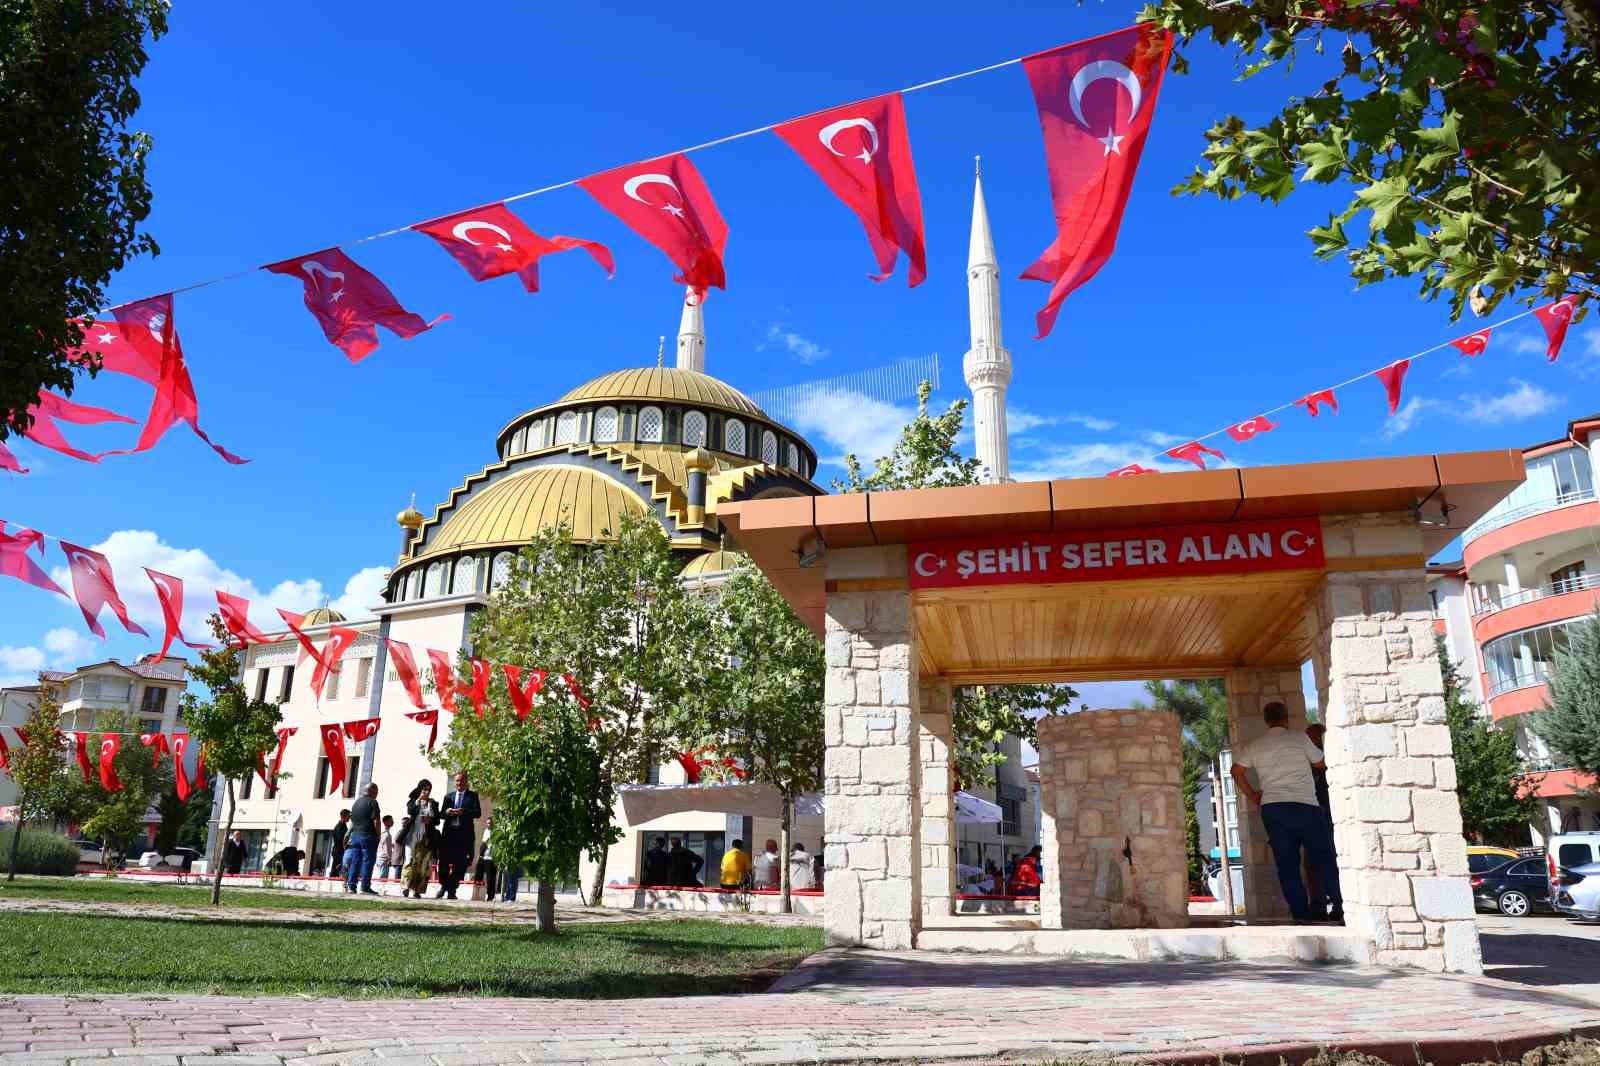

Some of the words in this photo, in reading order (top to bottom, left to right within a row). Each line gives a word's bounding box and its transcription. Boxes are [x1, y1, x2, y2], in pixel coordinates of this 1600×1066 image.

[957, 541, 1052, 579] ŞEHİT
[1062, 538, 1167, 569] SEFER
[1178, 532, 1273, 562] ALAN
